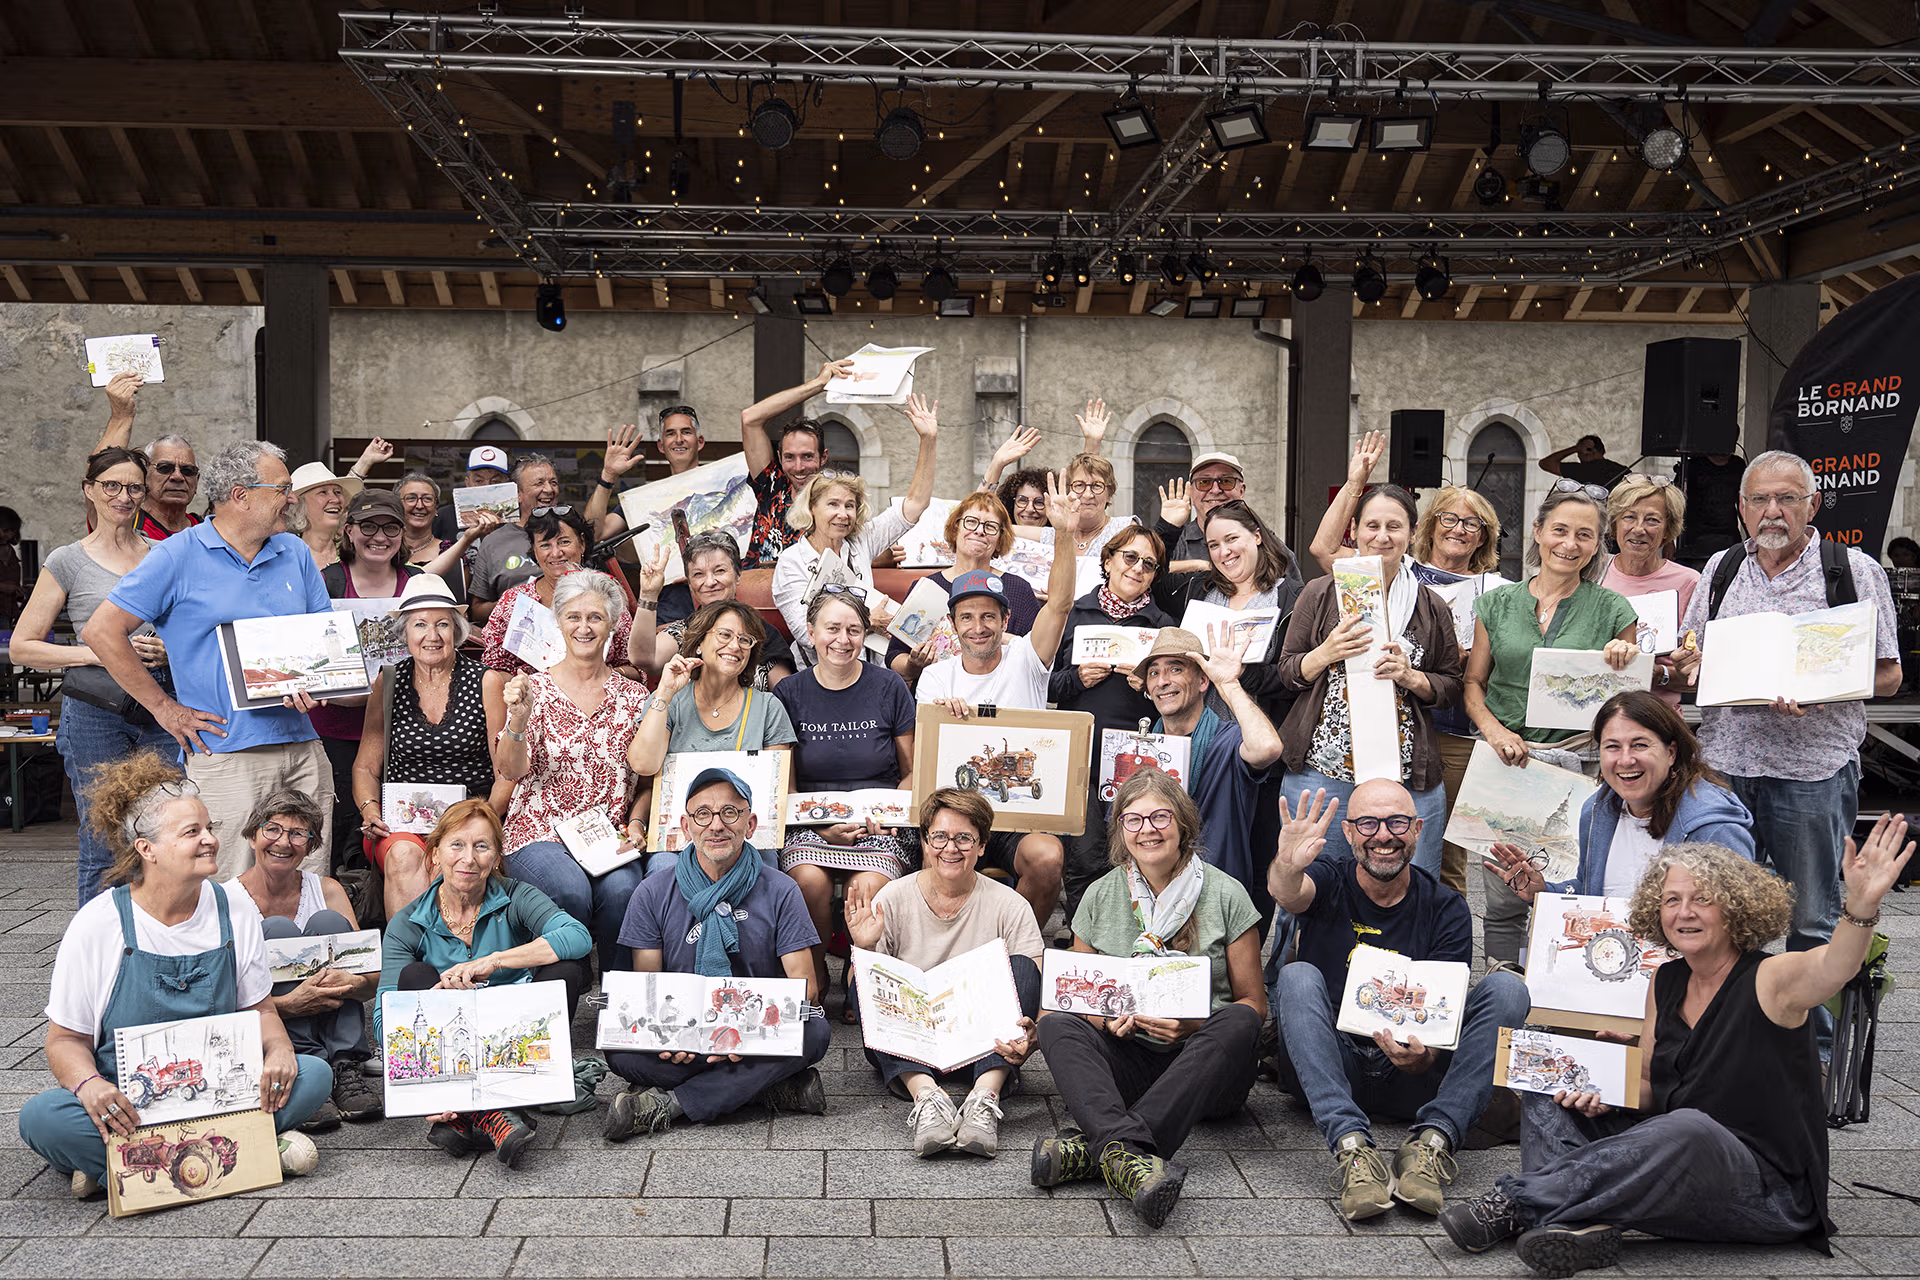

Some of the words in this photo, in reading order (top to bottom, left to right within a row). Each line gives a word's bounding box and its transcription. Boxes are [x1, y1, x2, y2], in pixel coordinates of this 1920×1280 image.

[1798, 385, 1822, 401] LE
[1827, 375, 1902, 398] GRAND
[1797, 392, 1901, 418] BORNAND
[1811, 452, 1881, 474] GRAND
[1814, 469, 1881, 490] RNAND
[1824, 529, 1864, 544] AND
[800, 722, 828, 732] TOM
[831, 719, 878, 732] TAILOR
